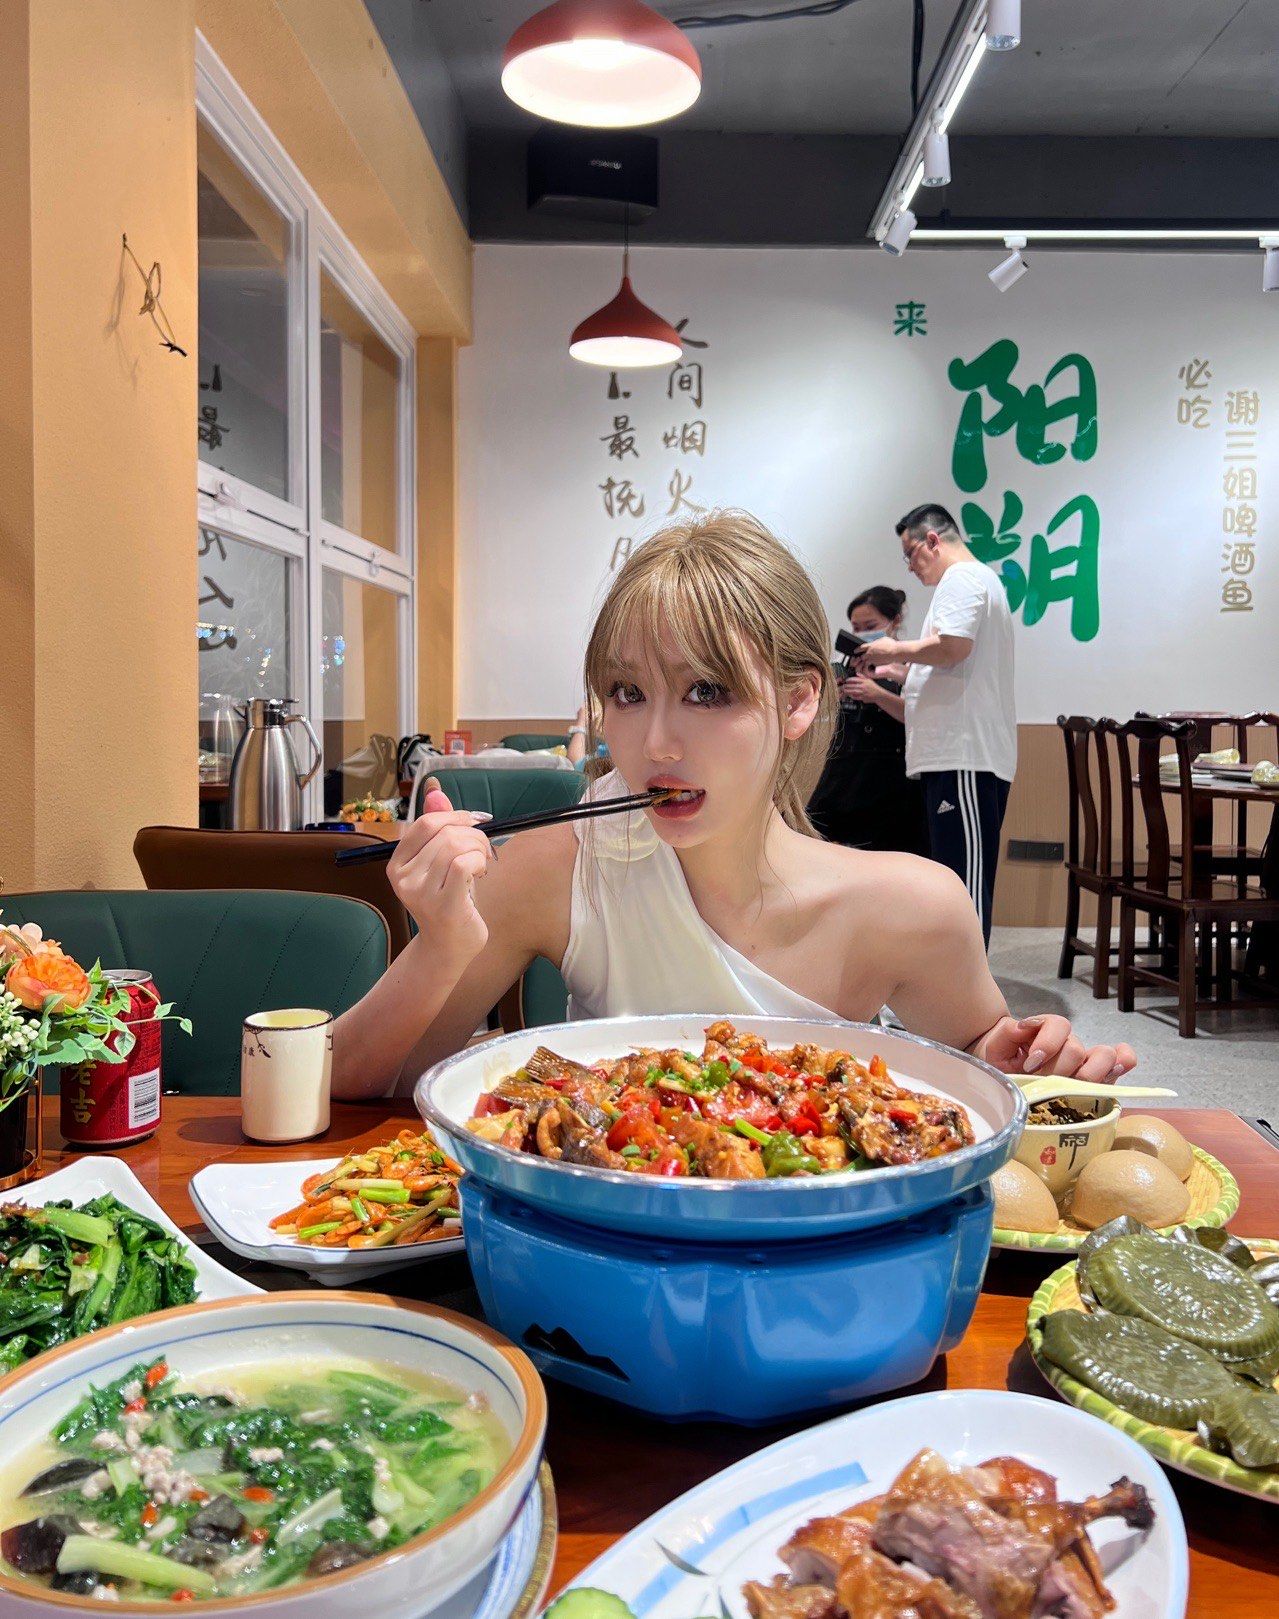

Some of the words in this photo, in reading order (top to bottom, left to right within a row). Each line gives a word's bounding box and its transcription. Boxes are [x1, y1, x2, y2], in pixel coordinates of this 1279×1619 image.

[893, 300, 928, 337] 来
[1177, 358, 1213, 430] 必吃
[947, 338, 1100, 643] 阳朔
[1220, 390, 1261, 613] 谢三姐啤酒鱼
